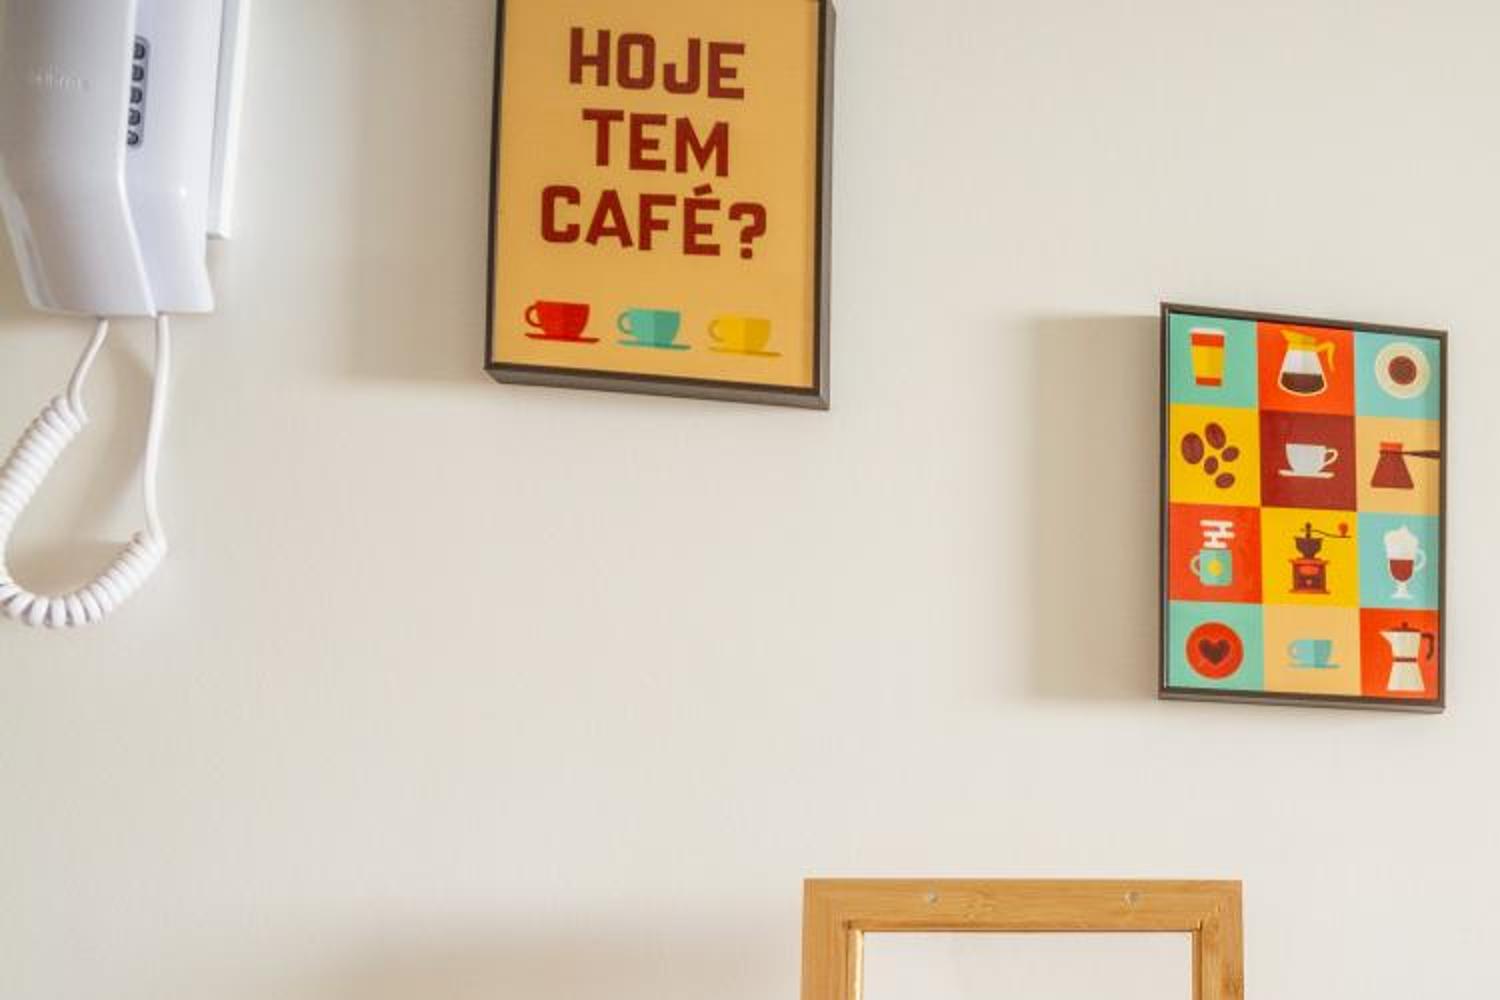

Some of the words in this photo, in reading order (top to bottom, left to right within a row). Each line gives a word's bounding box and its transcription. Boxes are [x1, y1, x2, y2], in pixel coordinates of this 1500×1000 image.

[568, 27, 746, 100] HOJE
[581, 108, 729, 178] TEM
[541, 183, 767, 260] CAFÉ?
